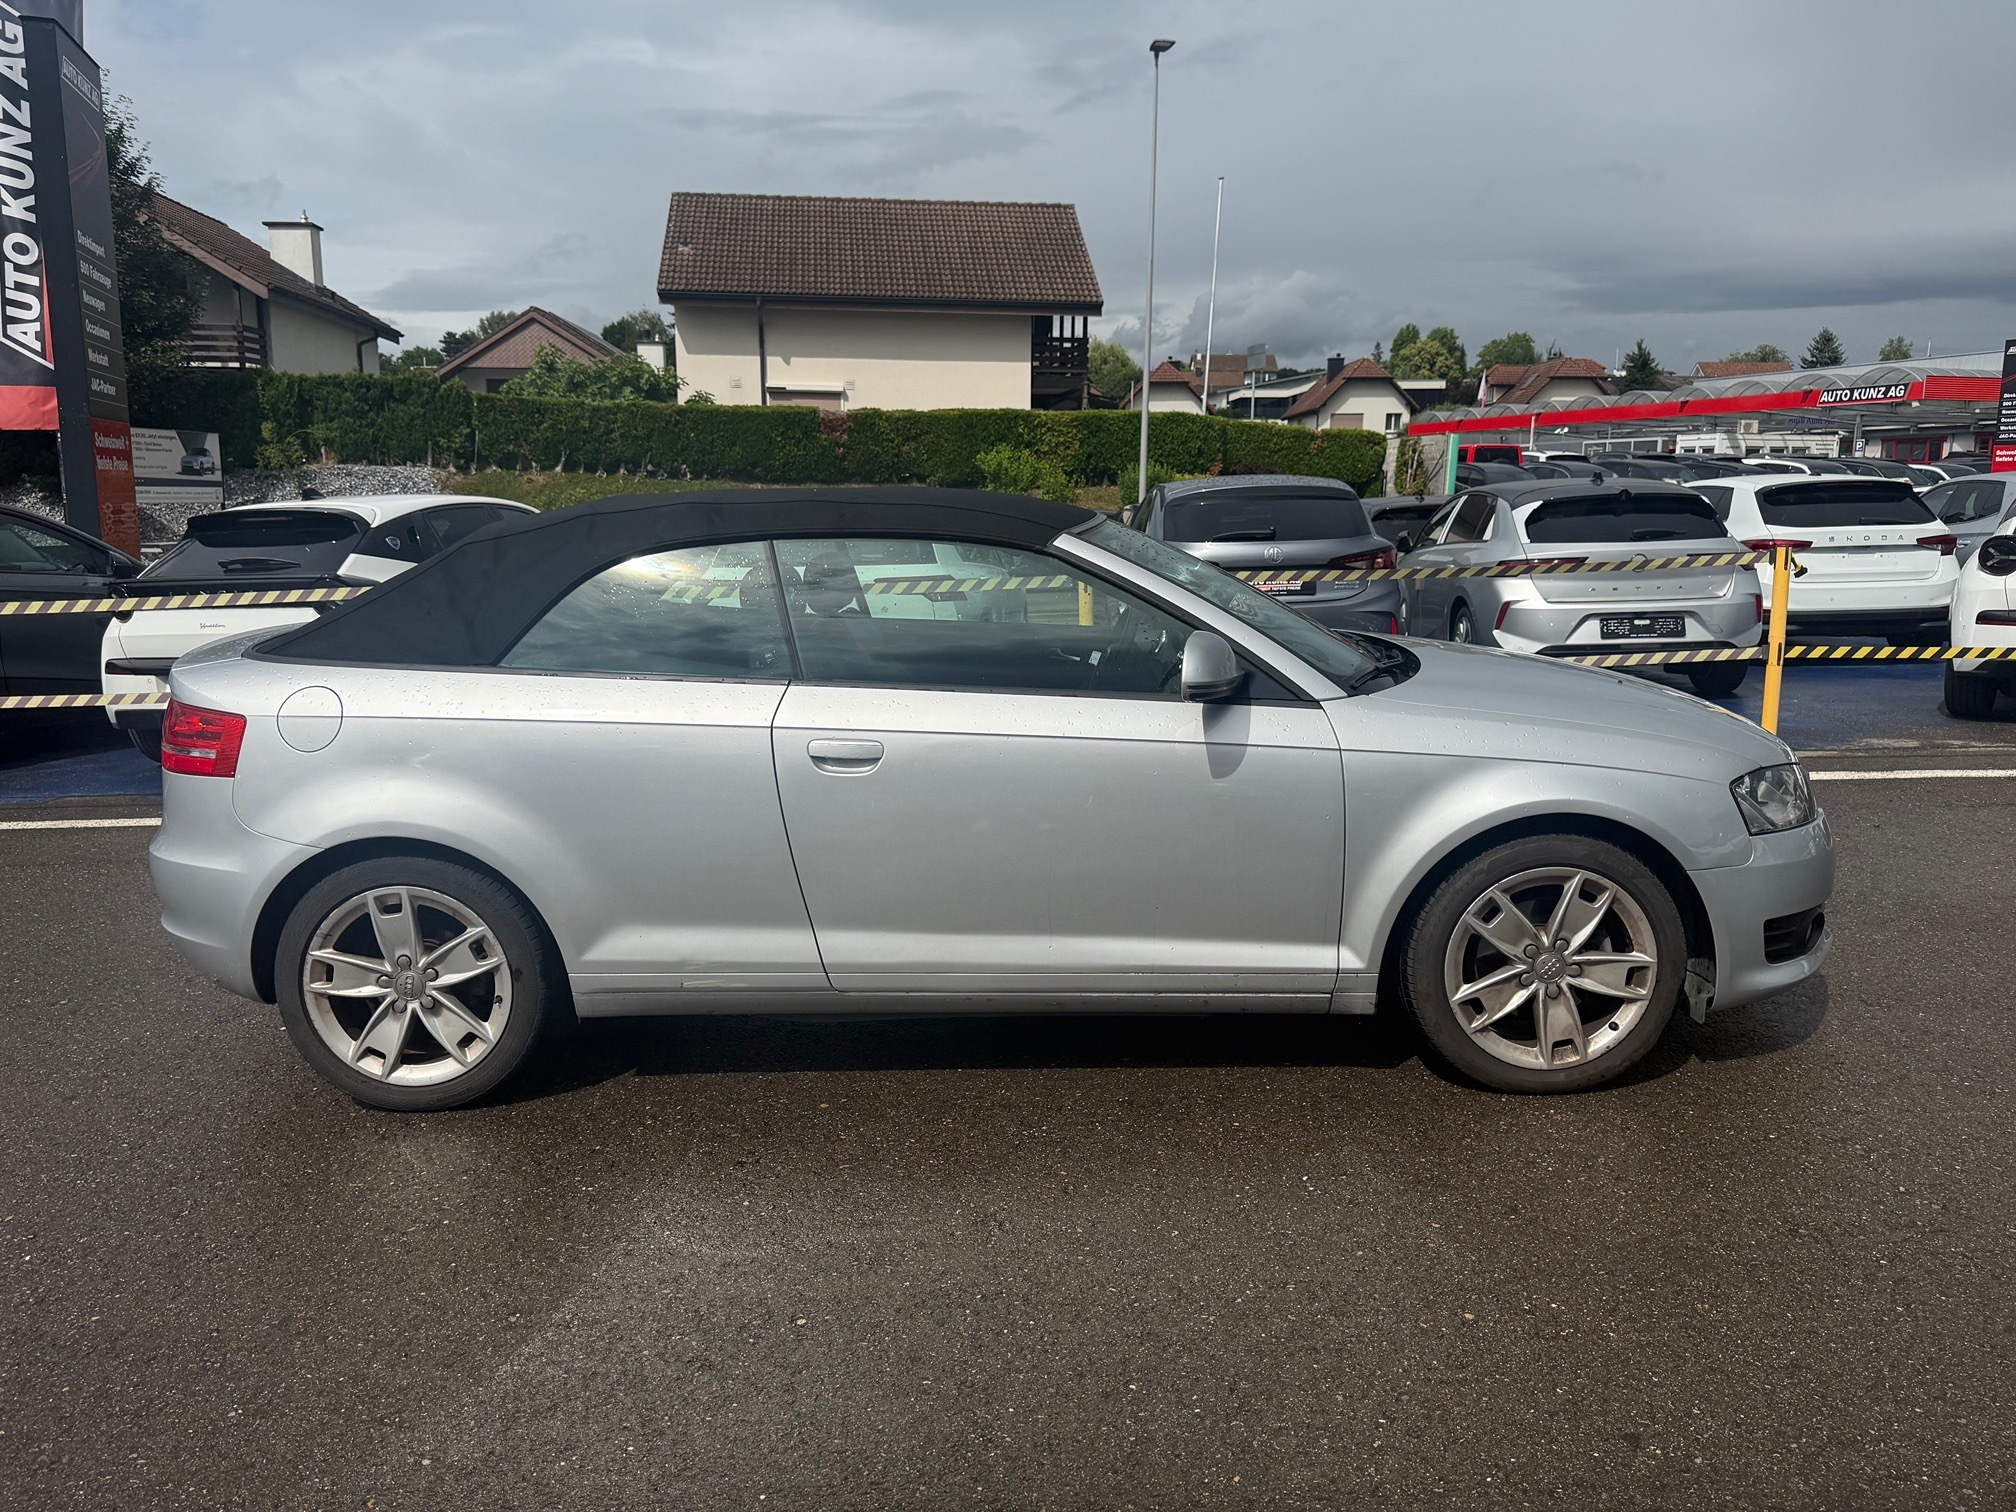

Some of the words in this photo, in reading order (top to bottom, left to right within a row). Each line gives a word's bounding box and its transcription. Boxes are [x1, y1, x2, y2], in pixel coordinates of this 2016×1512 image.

[0, 20, 29, 91] AG
[62, 60, 77, 84] AUTO
[78, 74, 92, 99] KUNZ
[0, 94, 36, 224] KUNZ
[77, 229, 105, 258] Direktimport
[80, 260, 89, 276] 500
[90, 265, 112, 289] Fahrzeuge
[3, 232, 41, 353] AUTO
[82, 289, 106, 312] Neuwagen
[85, 318, 111, 341] Occasionen
[87, 348, 109, 367] Werkstatt
[1820, 390, 1850, 402] AUTO
[1852, 387, 1886, 400] KUNZ
[1887, 385, 1905, 397] AG
[94, 431, 125, 450] Schweizweit
[113, 456, 129, 470] Preise
